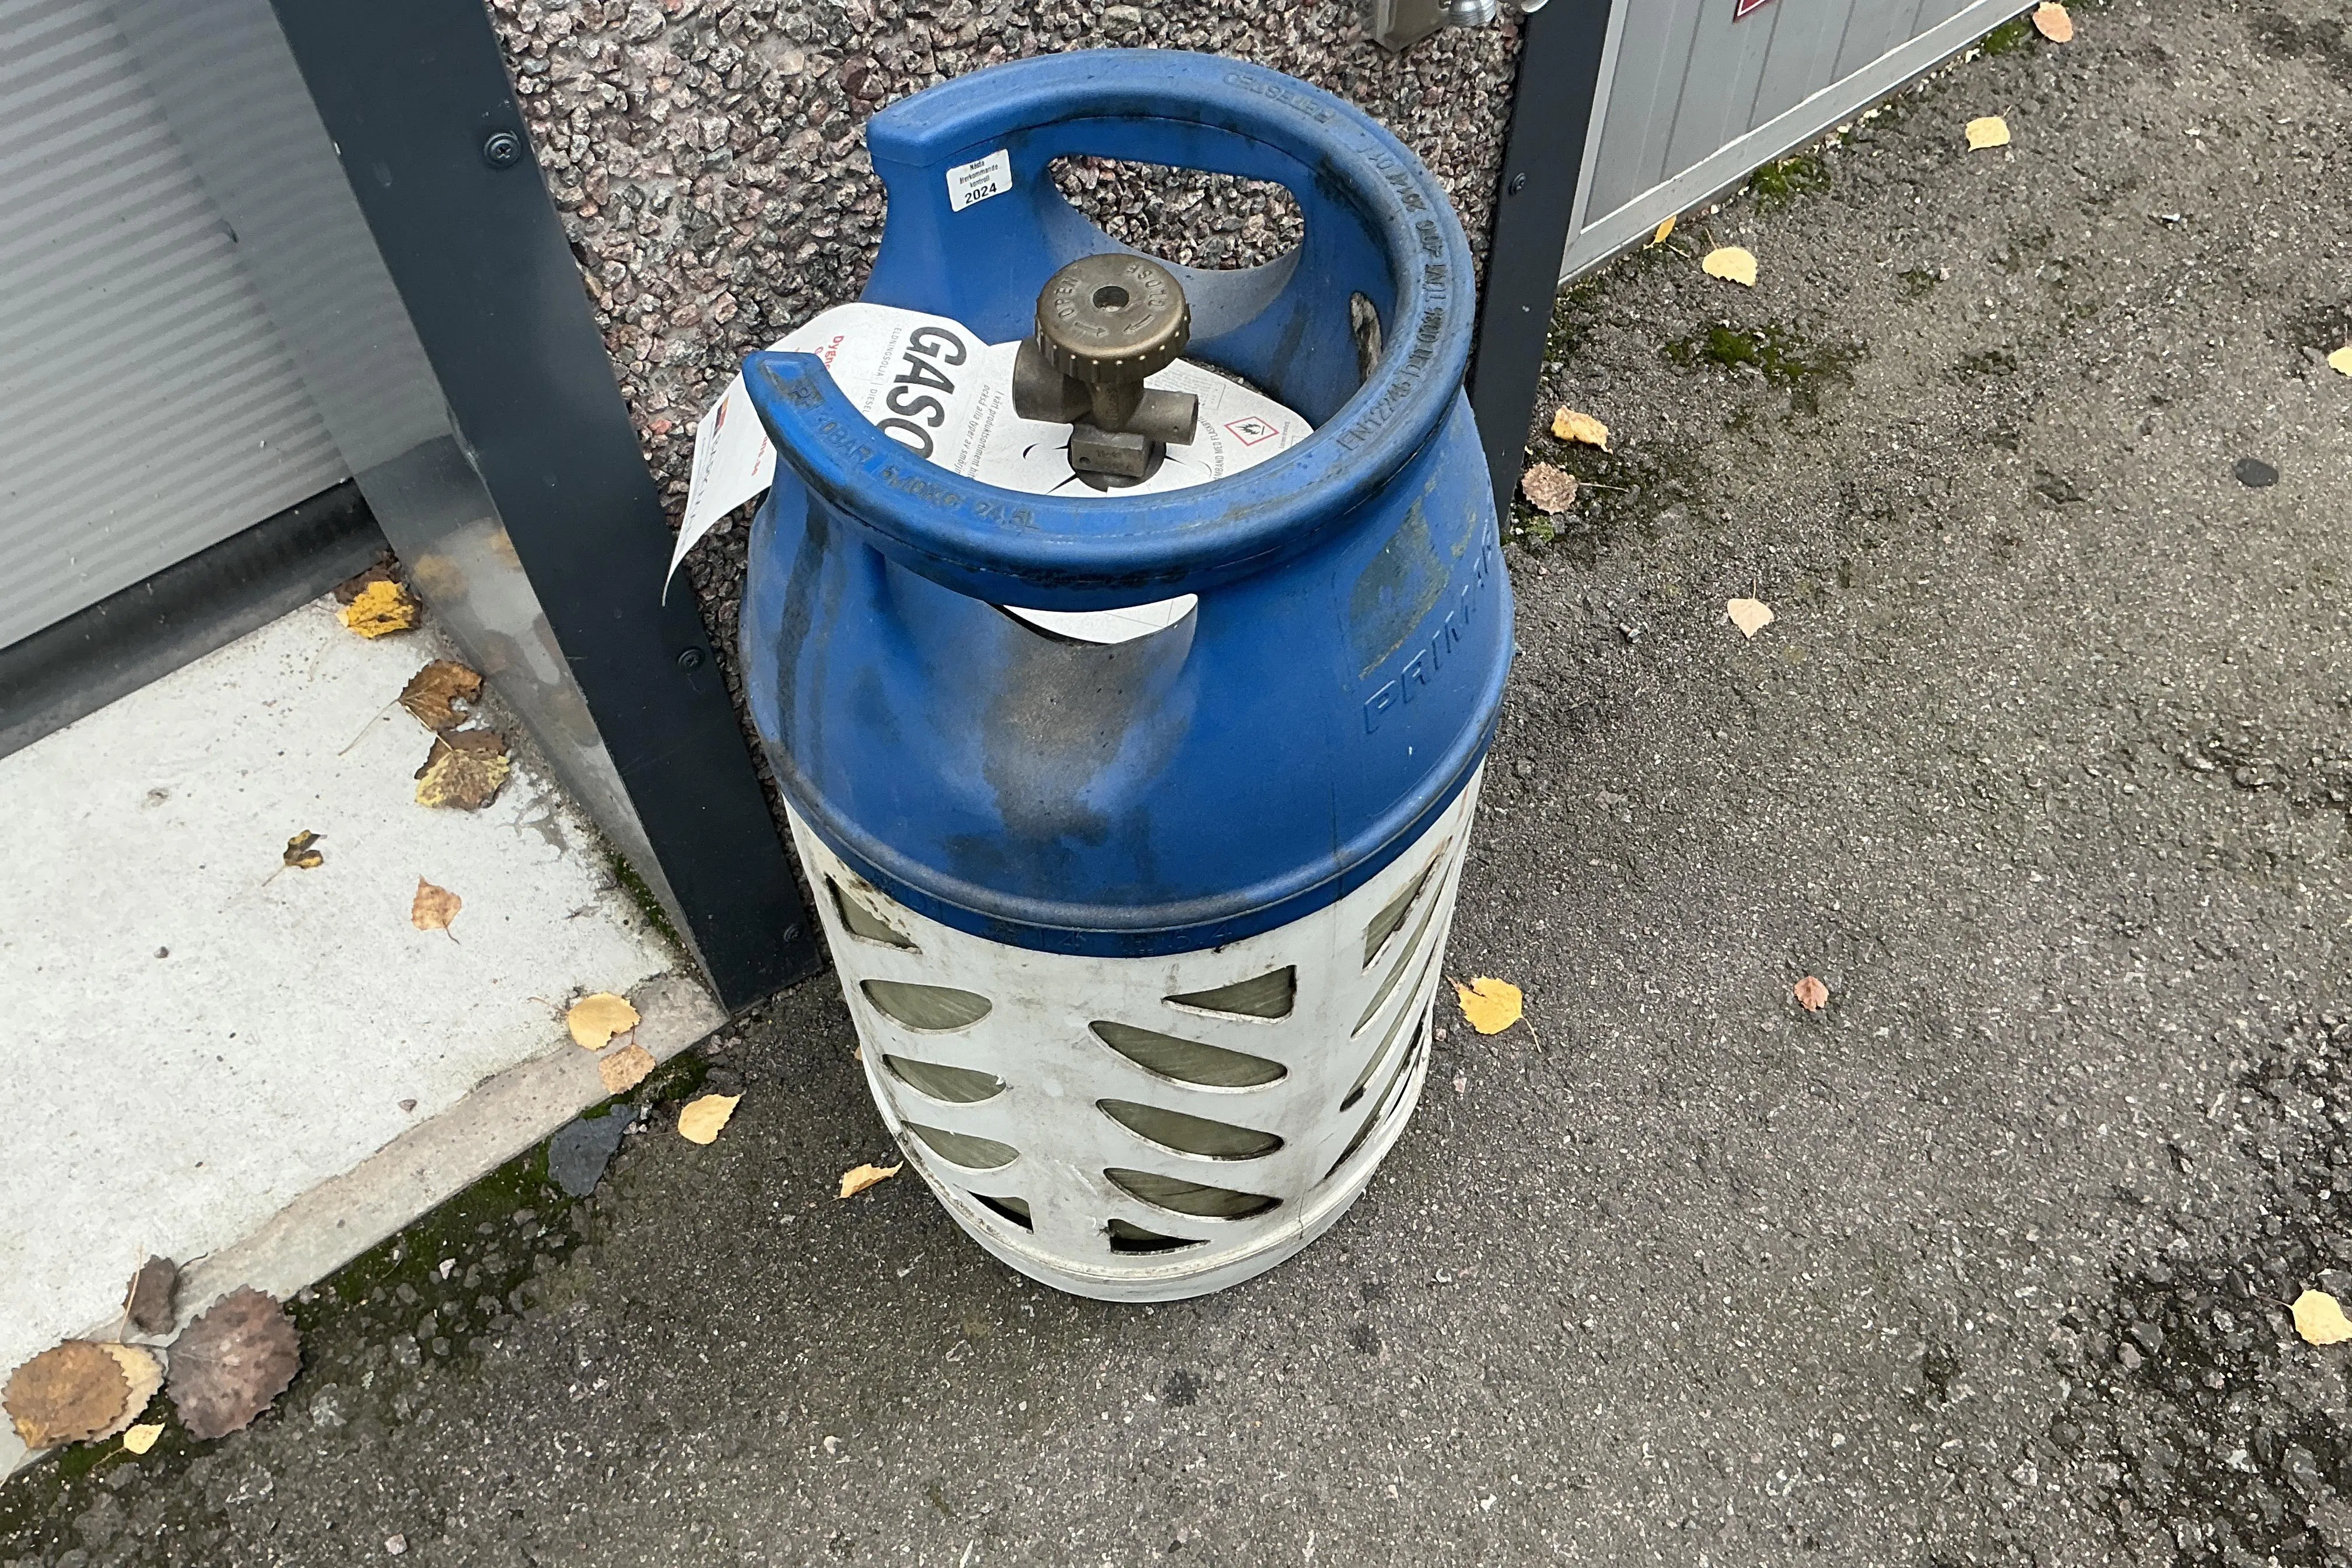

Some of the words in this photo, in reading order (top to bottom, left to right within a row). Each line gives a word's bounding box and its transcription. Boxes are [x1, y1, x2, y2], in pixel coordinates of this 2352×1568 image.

[970, 160, 985, 171] Nästa
[969, 175, 991, 188] kontroll
[964, 182, 998, 204] 2024
[1125, 263, 1168, 308] CLOSE
[1054, 276, 1082, 320] OPEN
[862, 388, 878, 413] DIESEL
[978, 384, 991, 407] också
[972, 405, 984, 420] alla
[967, 420, 979, 440] typer
[971, 408, 997, 467] produktsortiment
[964, 439, 972, 450] av
[1212, 441, 1224, 454] MED
